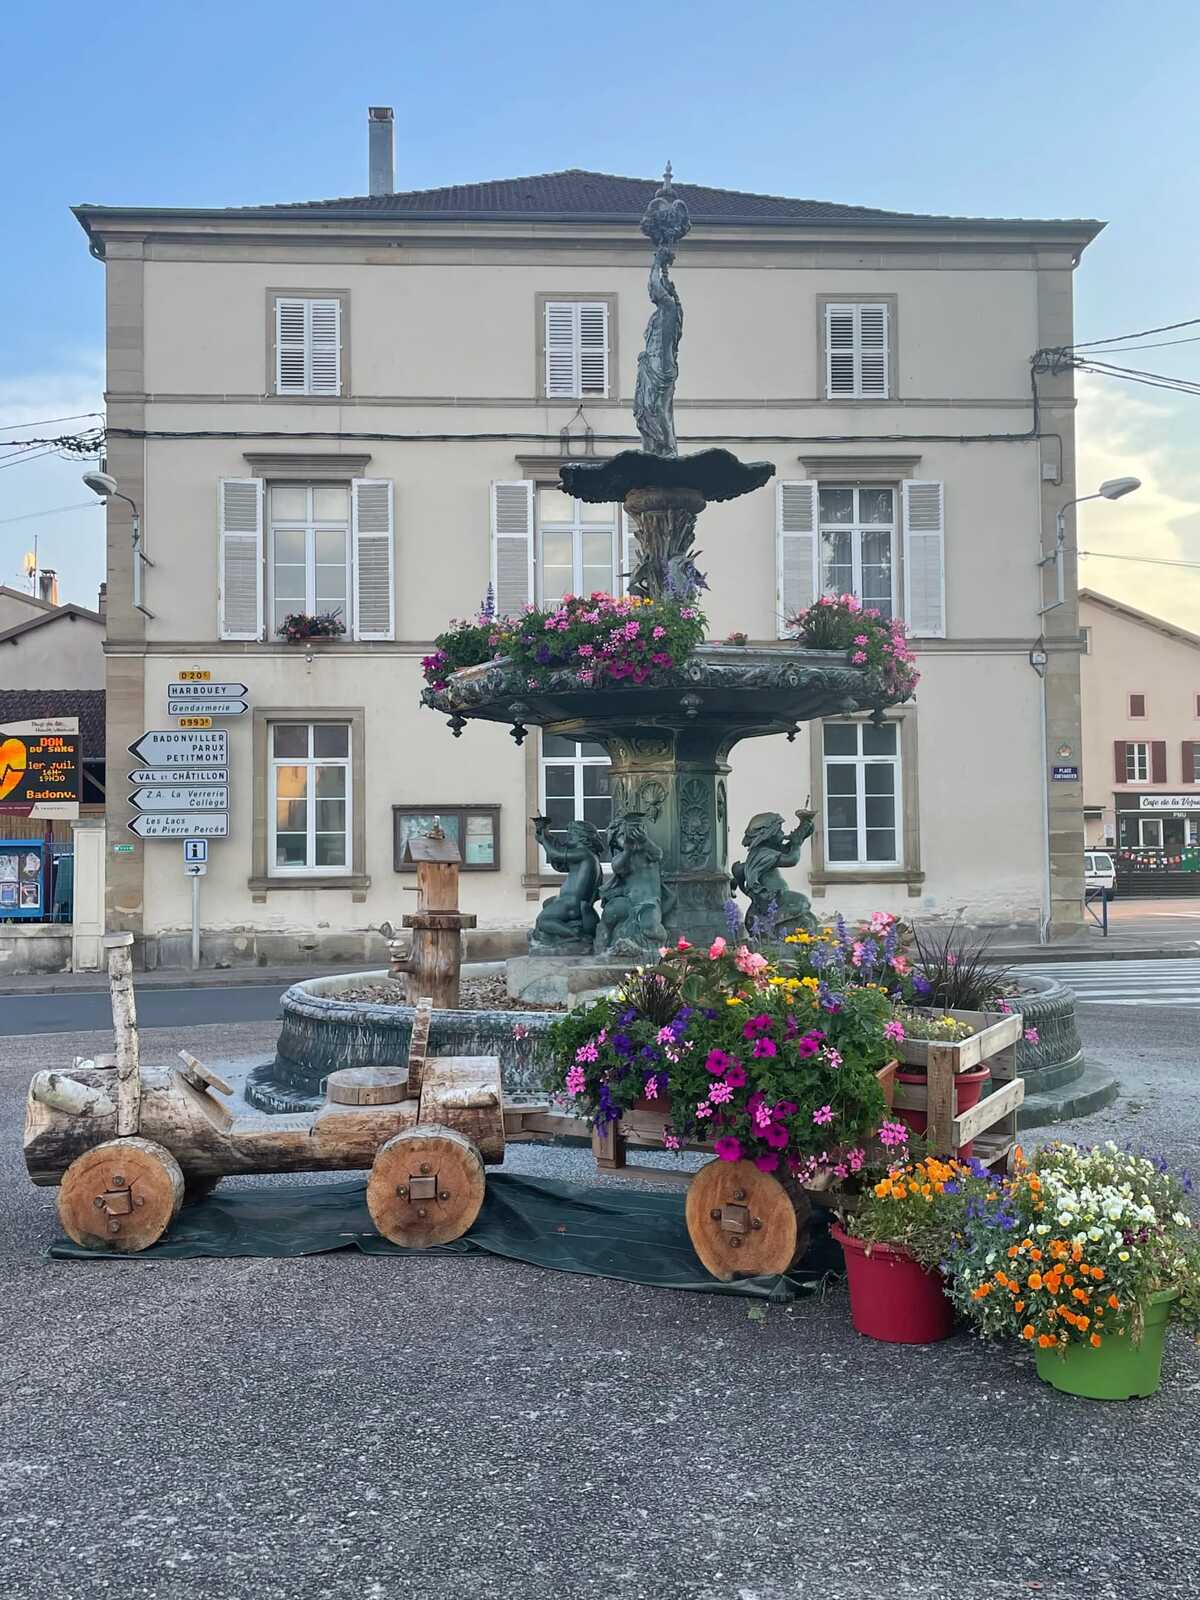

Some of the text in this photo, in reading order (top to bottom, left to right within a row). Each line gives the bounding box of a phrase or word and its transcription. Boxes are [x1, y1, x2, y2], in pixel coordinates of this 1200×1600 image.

[172, 704, 230, 712] Gendarmerie
[40, 737, 63, 747] DON
[153, 734, 224, 743] BADONVILLER
[192, 744, 225, 752] PARUX
[167, 754, 225, 762] PETITMONT
[139, 773, 157, 781] VAL
[172, 771, 225, 781] CHÂTILLON
[26, 790, 77, 799] Badonv.
[188, 790, 225, 798] Verrerie
[146, 816, 186, 825] Les Lacs
[146, 826, 157, 834] de
[161, 826, 190, 834] Pierre
